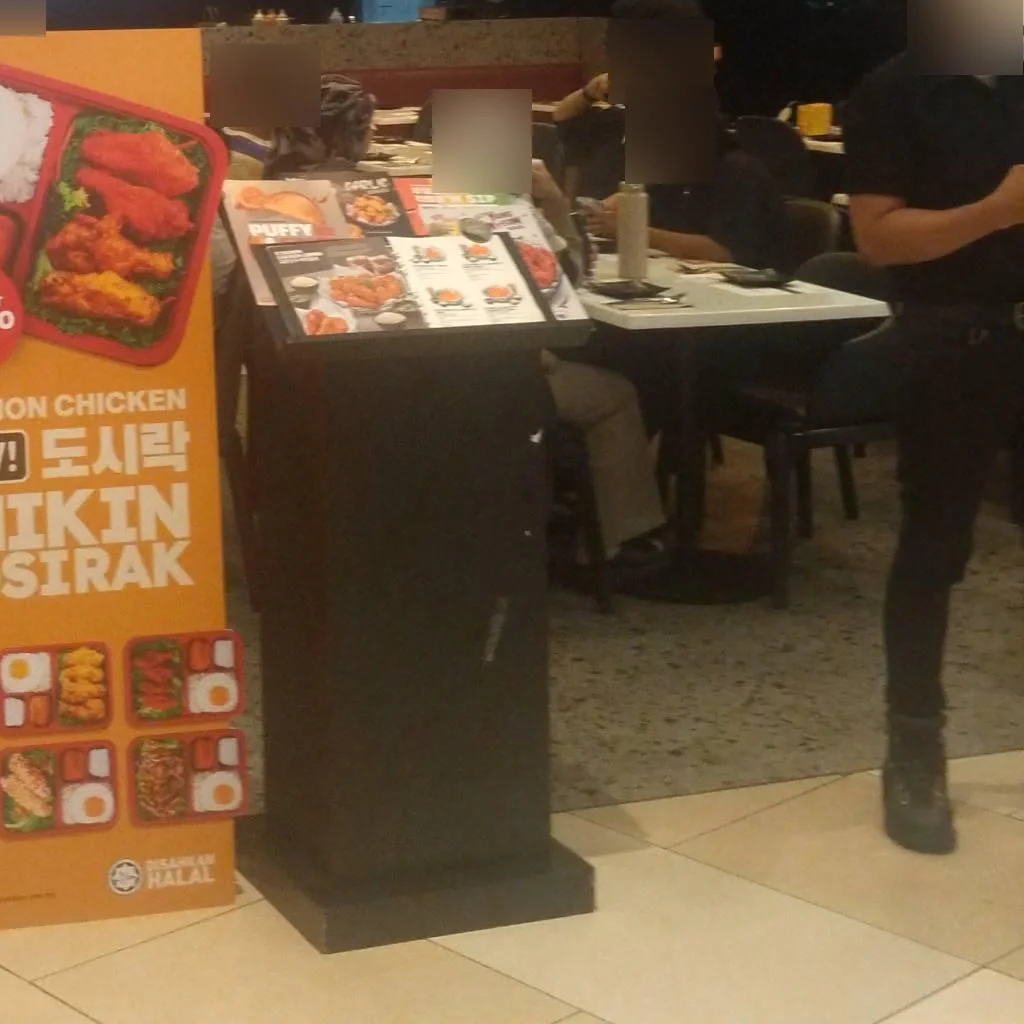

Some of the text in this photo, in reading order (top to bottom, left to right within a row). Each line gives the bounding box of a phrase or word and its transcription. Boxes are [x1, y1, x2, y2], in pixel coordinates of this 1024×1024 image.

[248, 222, 313, 238] PUFFY
[53, 387, 188, 419] CHICKEN
[41, 420, 191, 480] 도시락
[147, 865, 216, 890] HALAL
